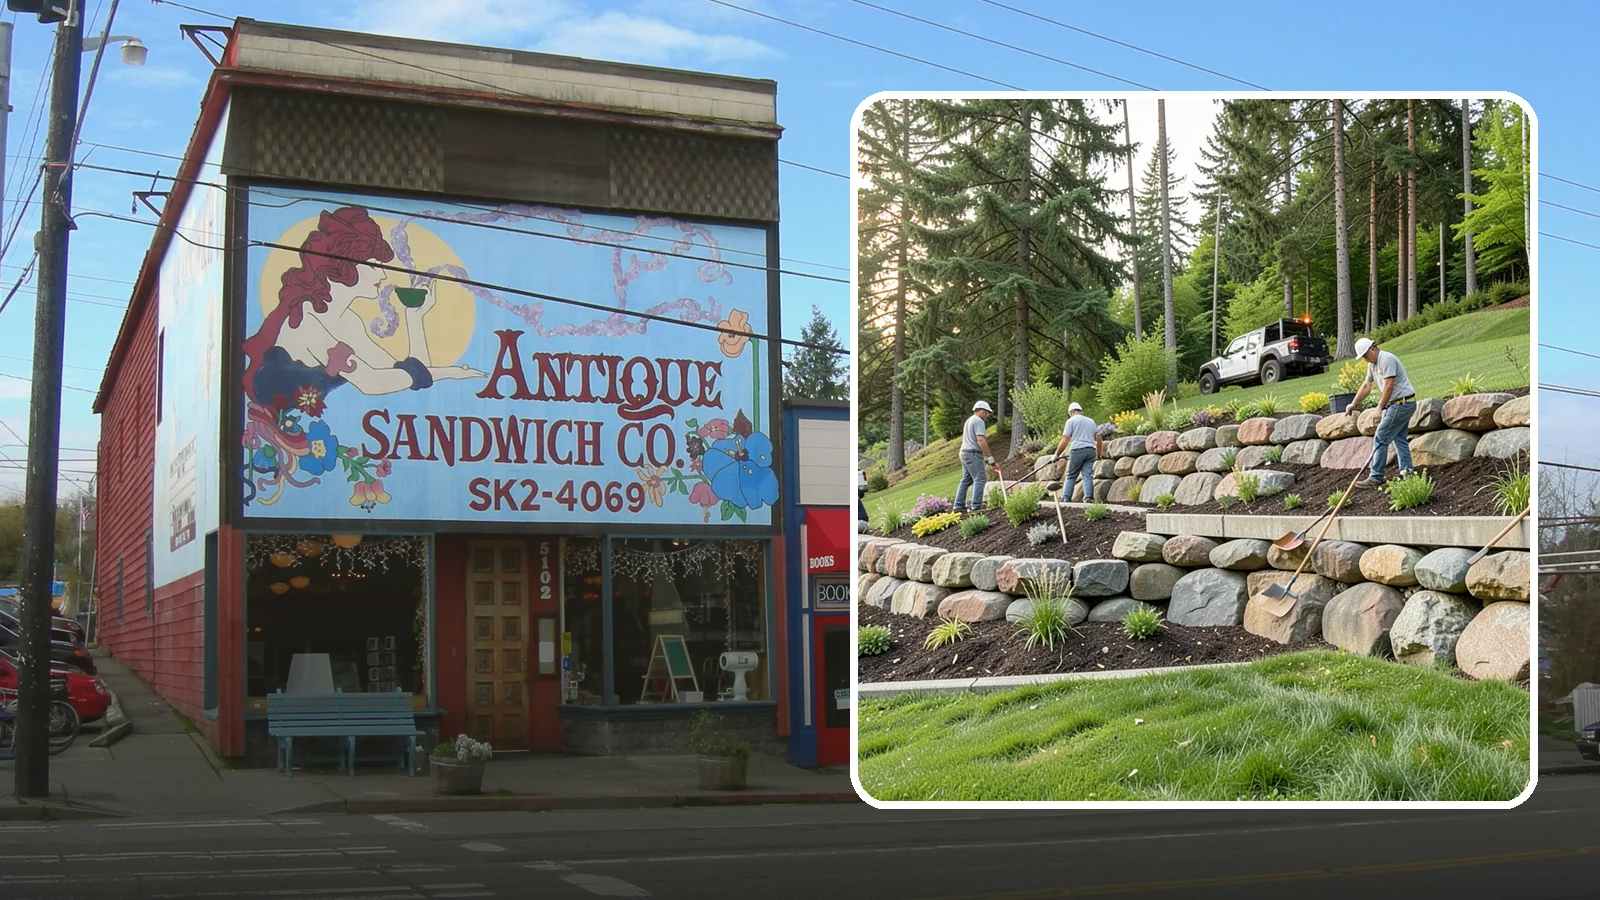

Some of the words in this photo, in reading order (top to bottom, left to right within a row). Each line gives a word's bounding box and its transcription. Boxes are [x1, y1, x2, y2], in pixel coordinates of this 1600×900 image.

[475, 328, 724, 421] ANTIQUE
[360, 408, 605, 468] SANDWICH
[616, 420, 685, 470] CO.
[468, 477, 646, 513] SK2-4069
[539, 541, 552, 600] 5102
[809, 555, 835, 569] BOOKS
